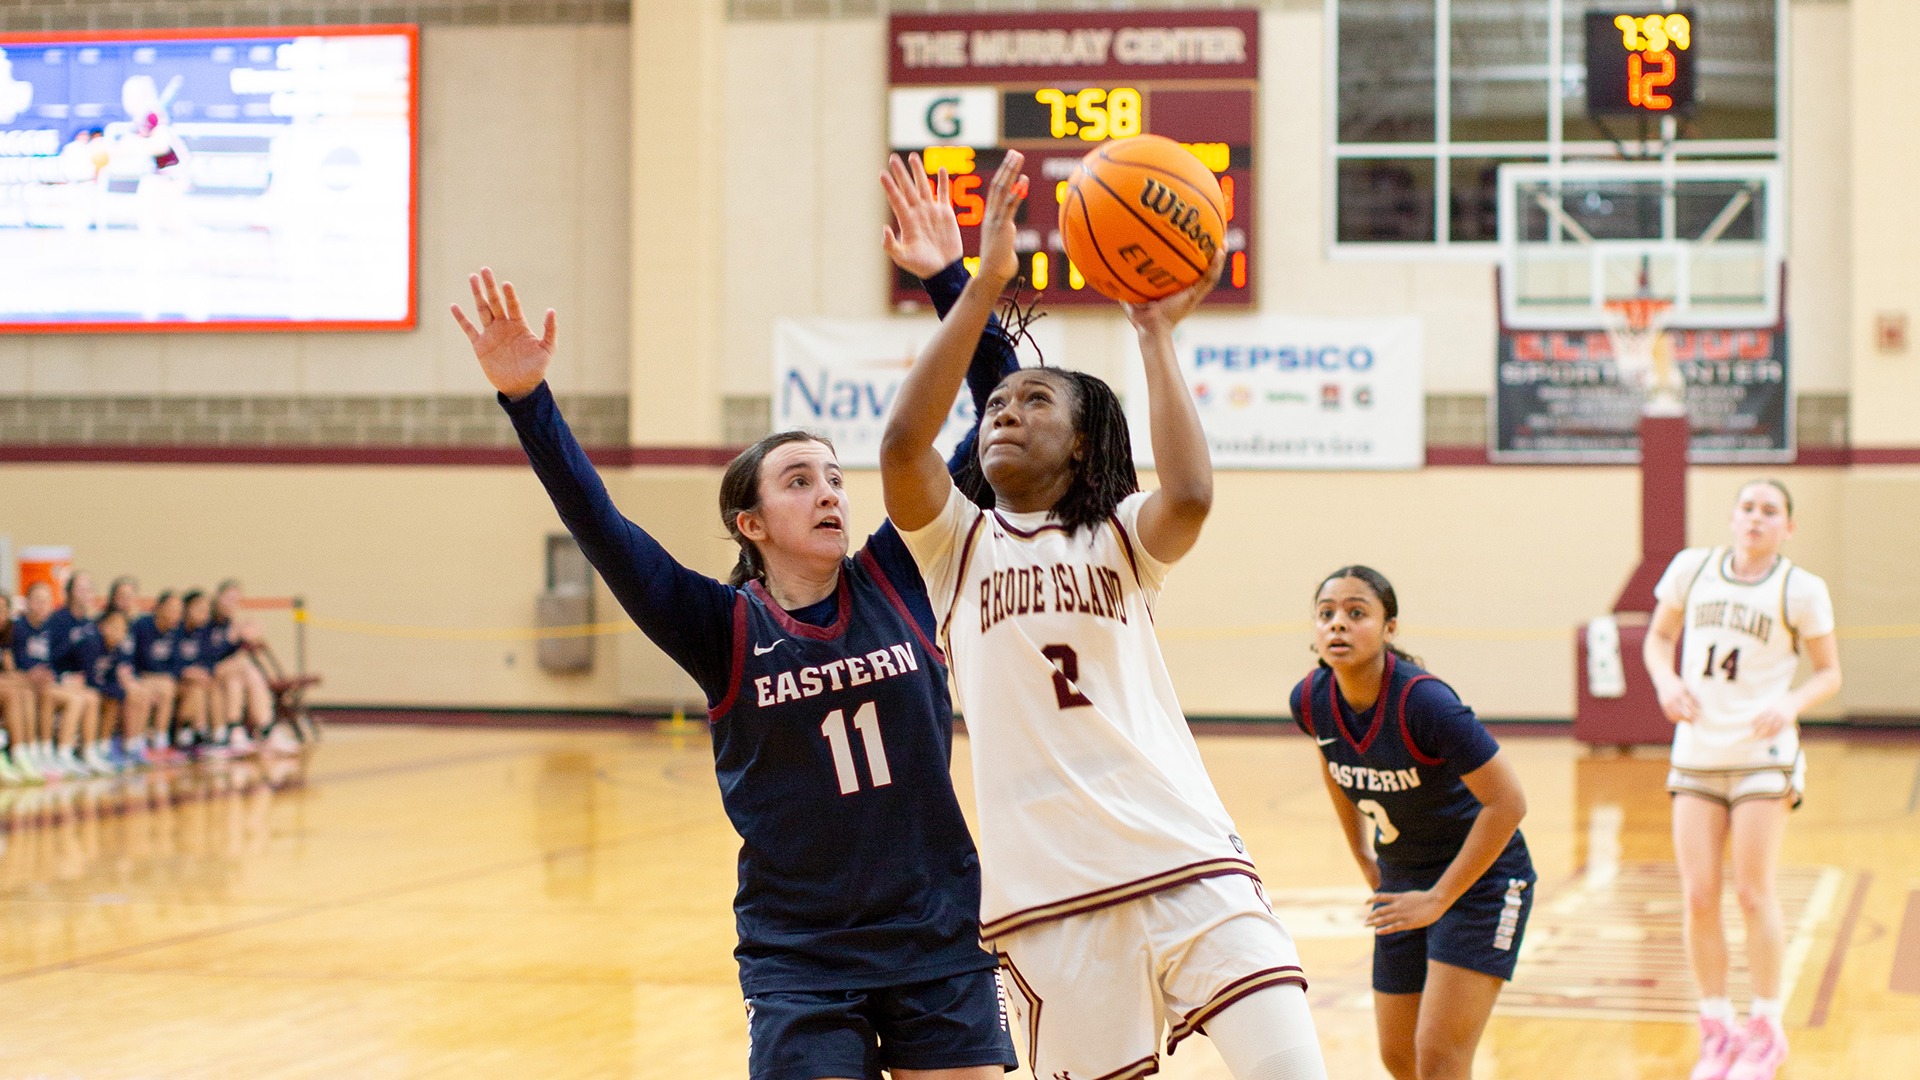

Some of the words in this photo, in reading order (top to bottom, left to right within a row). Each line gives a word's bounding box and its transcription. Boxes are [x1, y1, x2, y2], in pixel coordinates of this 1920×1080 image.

[902, 32, 967, 67] THE
[971, 28, 1112, 67] MURRAY
[1114, 26, 1246, 65] CENTER
[1628, 50, 1676, 110] 12
[925, 97, 963, 138] G
[1036, 87, 1141, 141] 7:58
[1195, 346, 1373, 371] PEPSICO
[1207, 433, 1373, 454] oodservice
[981, 565, 1045, 634] RHODE
[1051, 563, 1127, 625] ISLAND
[754, 641, 919, 708] EASTERN
[1040, 644, 1093, 710] 2
[1702, 643, 1740, 682] 14
[820, 700, 893, 796] 11
[1328, 761, 1421, 792] ASTERN
